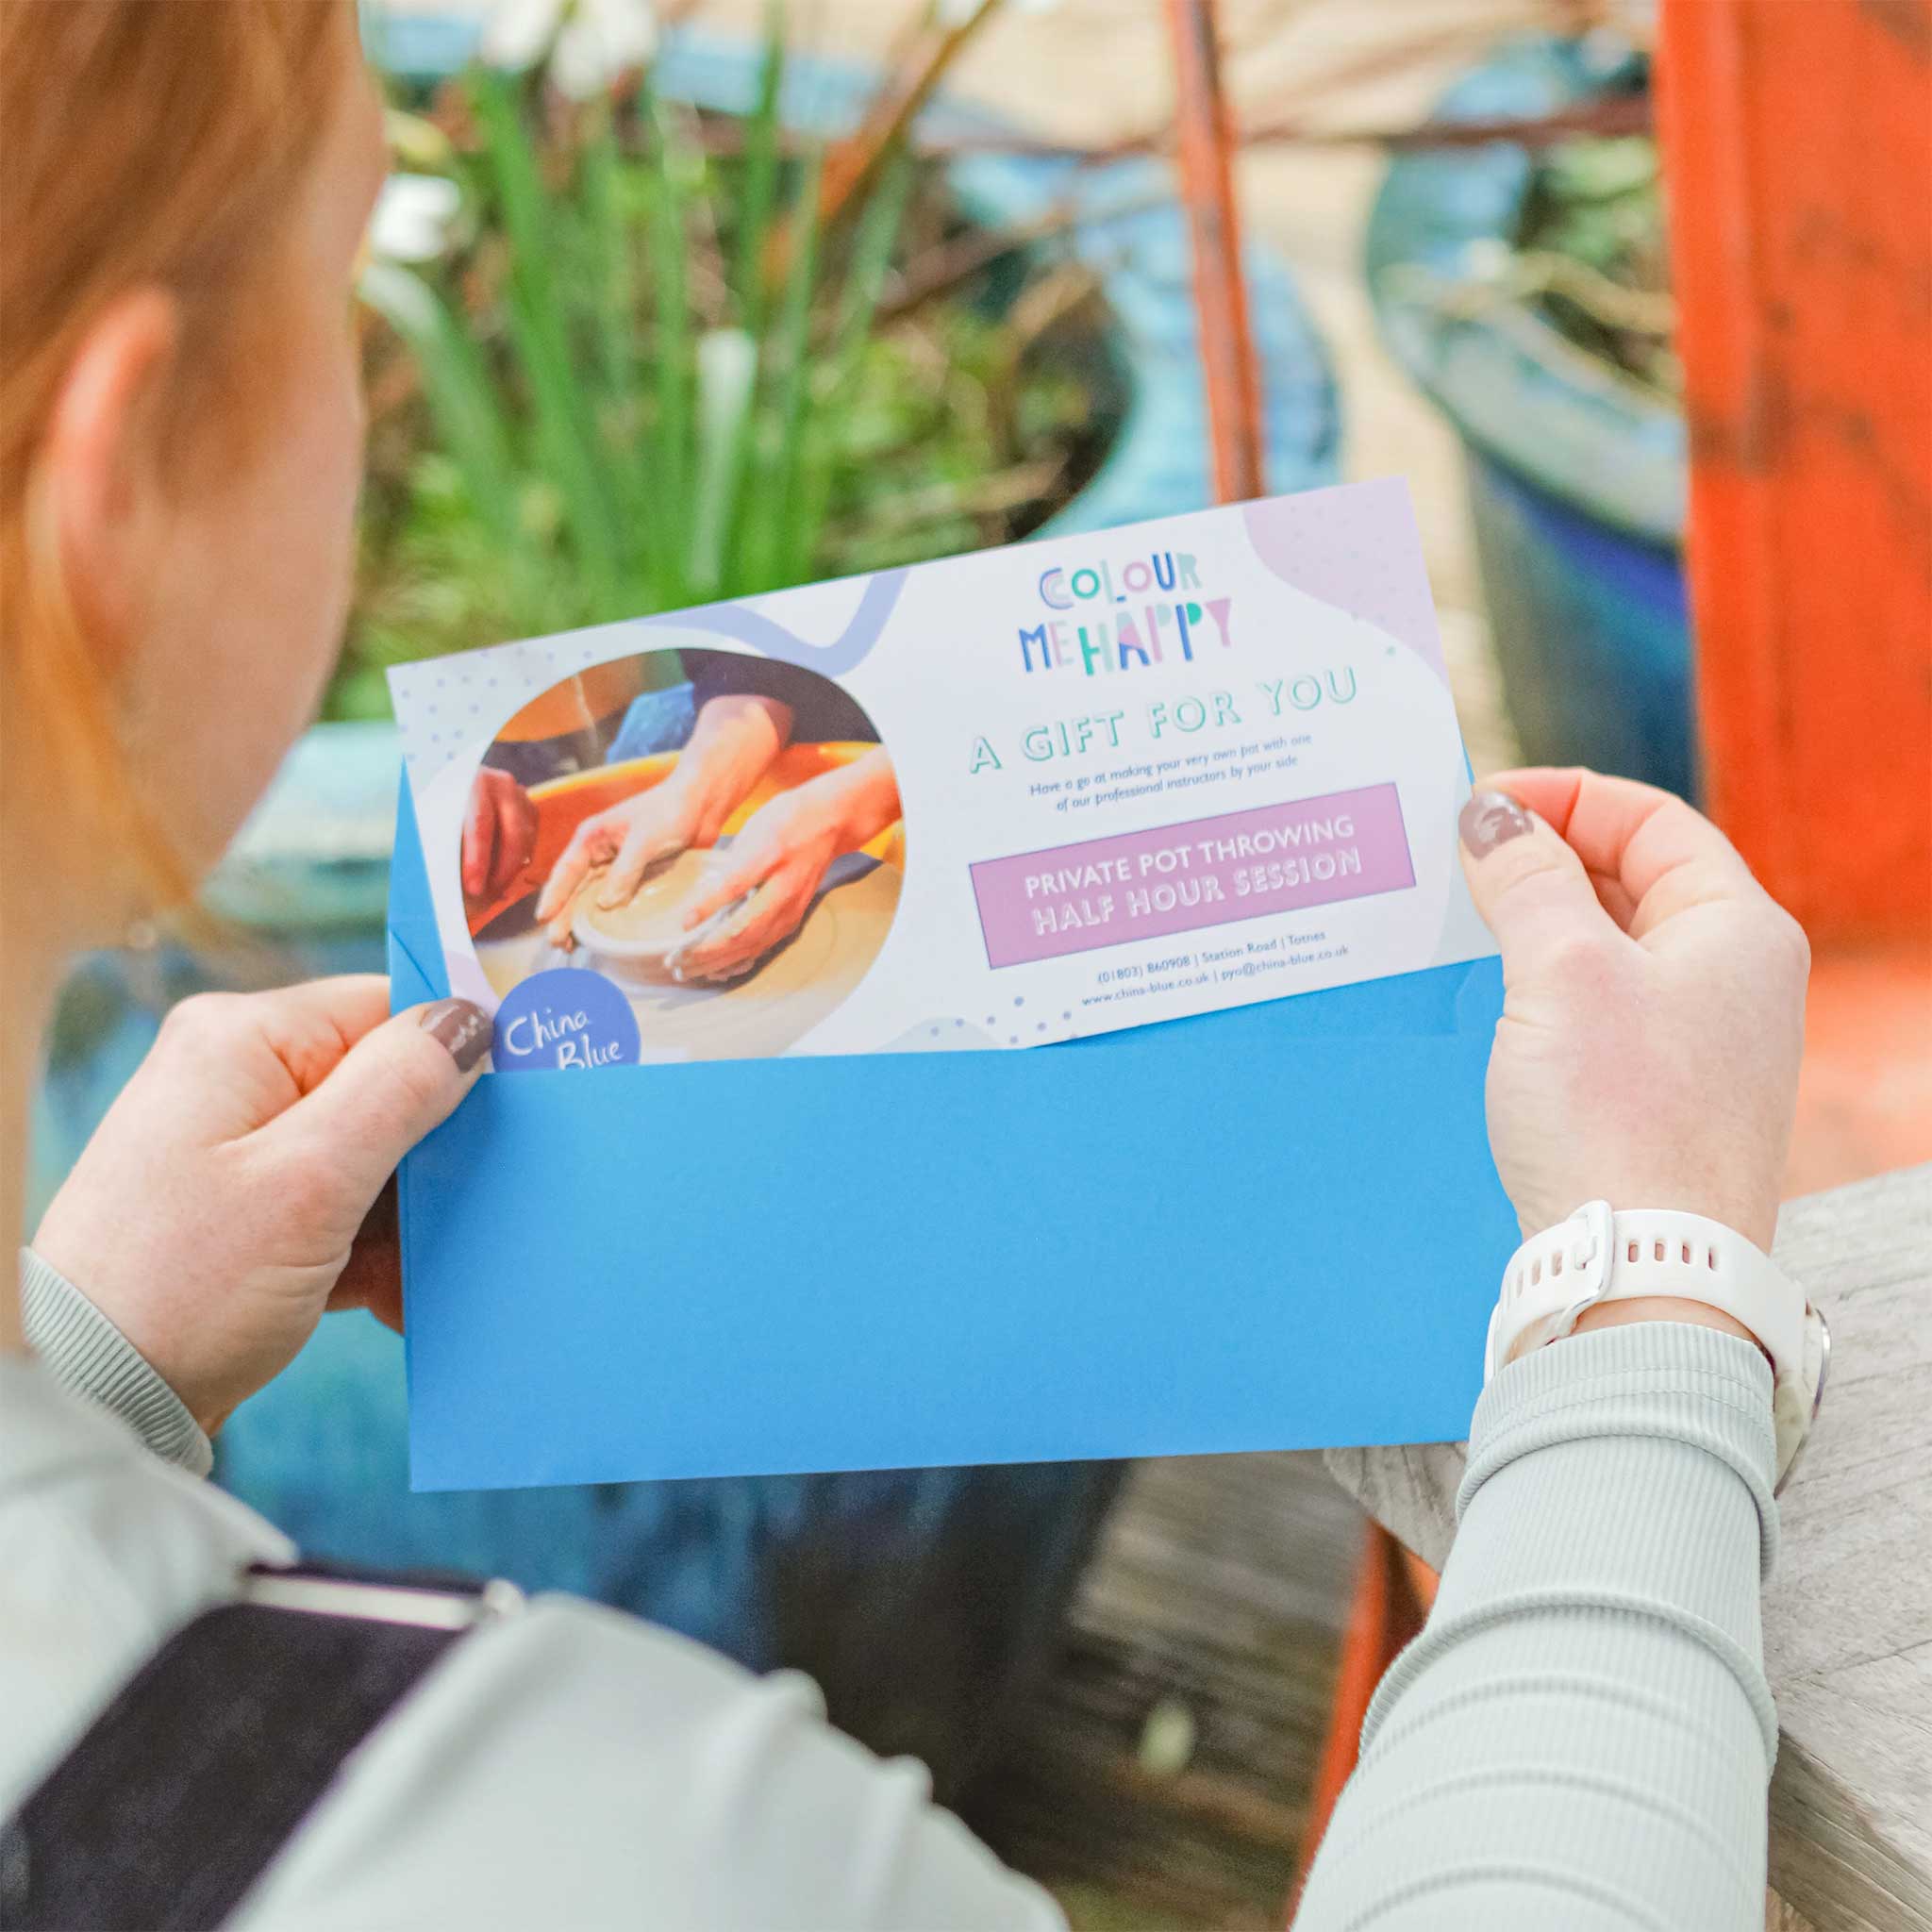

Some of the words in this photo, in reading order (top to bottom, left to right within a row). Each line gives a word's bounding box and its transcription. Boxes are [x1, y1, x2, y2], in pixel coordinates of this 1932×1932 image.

[1039, 551, 1204, 609] COLOUR
[968, 737, 1002, 774] A
[1021, 710, 1124, 762] GIFT
[1146, 690, 1241, 739] FOR
[1257, 666, 1358, 716] YOU
[1030, 782, 1061, 796] Have
[1065, 781, 1073, 790] a
[1077, 776, 1091, 791] go
[1095, 773, 1107, 783] at
[1110, 764, 1153, 780] making
[1157, 759, 1181, 775] your
[1186, 755, 1209, 769] very
[1213, 751, 1237, 761] own
[1241, 743, 1259, 758] pot
[1262, 738, 1287, 751] with
[1291, 735, 1312, 745] one
[1057, 799, 1070, 812] of
[1072, 795, 1091, 808] our
[1095, 780, 1164, 806] professional
[1167, 770, 1226, 790] instructors
[1230, 765, 1243, 779] by
[1247, 761, 1272, 776] your
[1275, 756, 1298, 769] side
[1025, 858, 1131, 898] PRIVATE
[1140, 846, 1191, 880] POT
[1198, 815, 1356, 866] THROWING
[1032, 891, 1115, 936] HALF
[1128, 874, 1225, 918] HOUR
[1236, 847, 1362, 896] SESSION
[1082, 972, 1209, 1006] www.china-blue.co.uk
[1222, 945, 1349, 981] pyo@china-blue.co.uk
[1097, 965, 1143, 985] (01803)
[1147, 955, 1191, 974] 860908
[1202, 946, 1244, 964] Station
[1247, 940, 1277, 955] Road
[1288, 931, 1325, 946] Totnes
[505, 1007, 590, 1056] China
